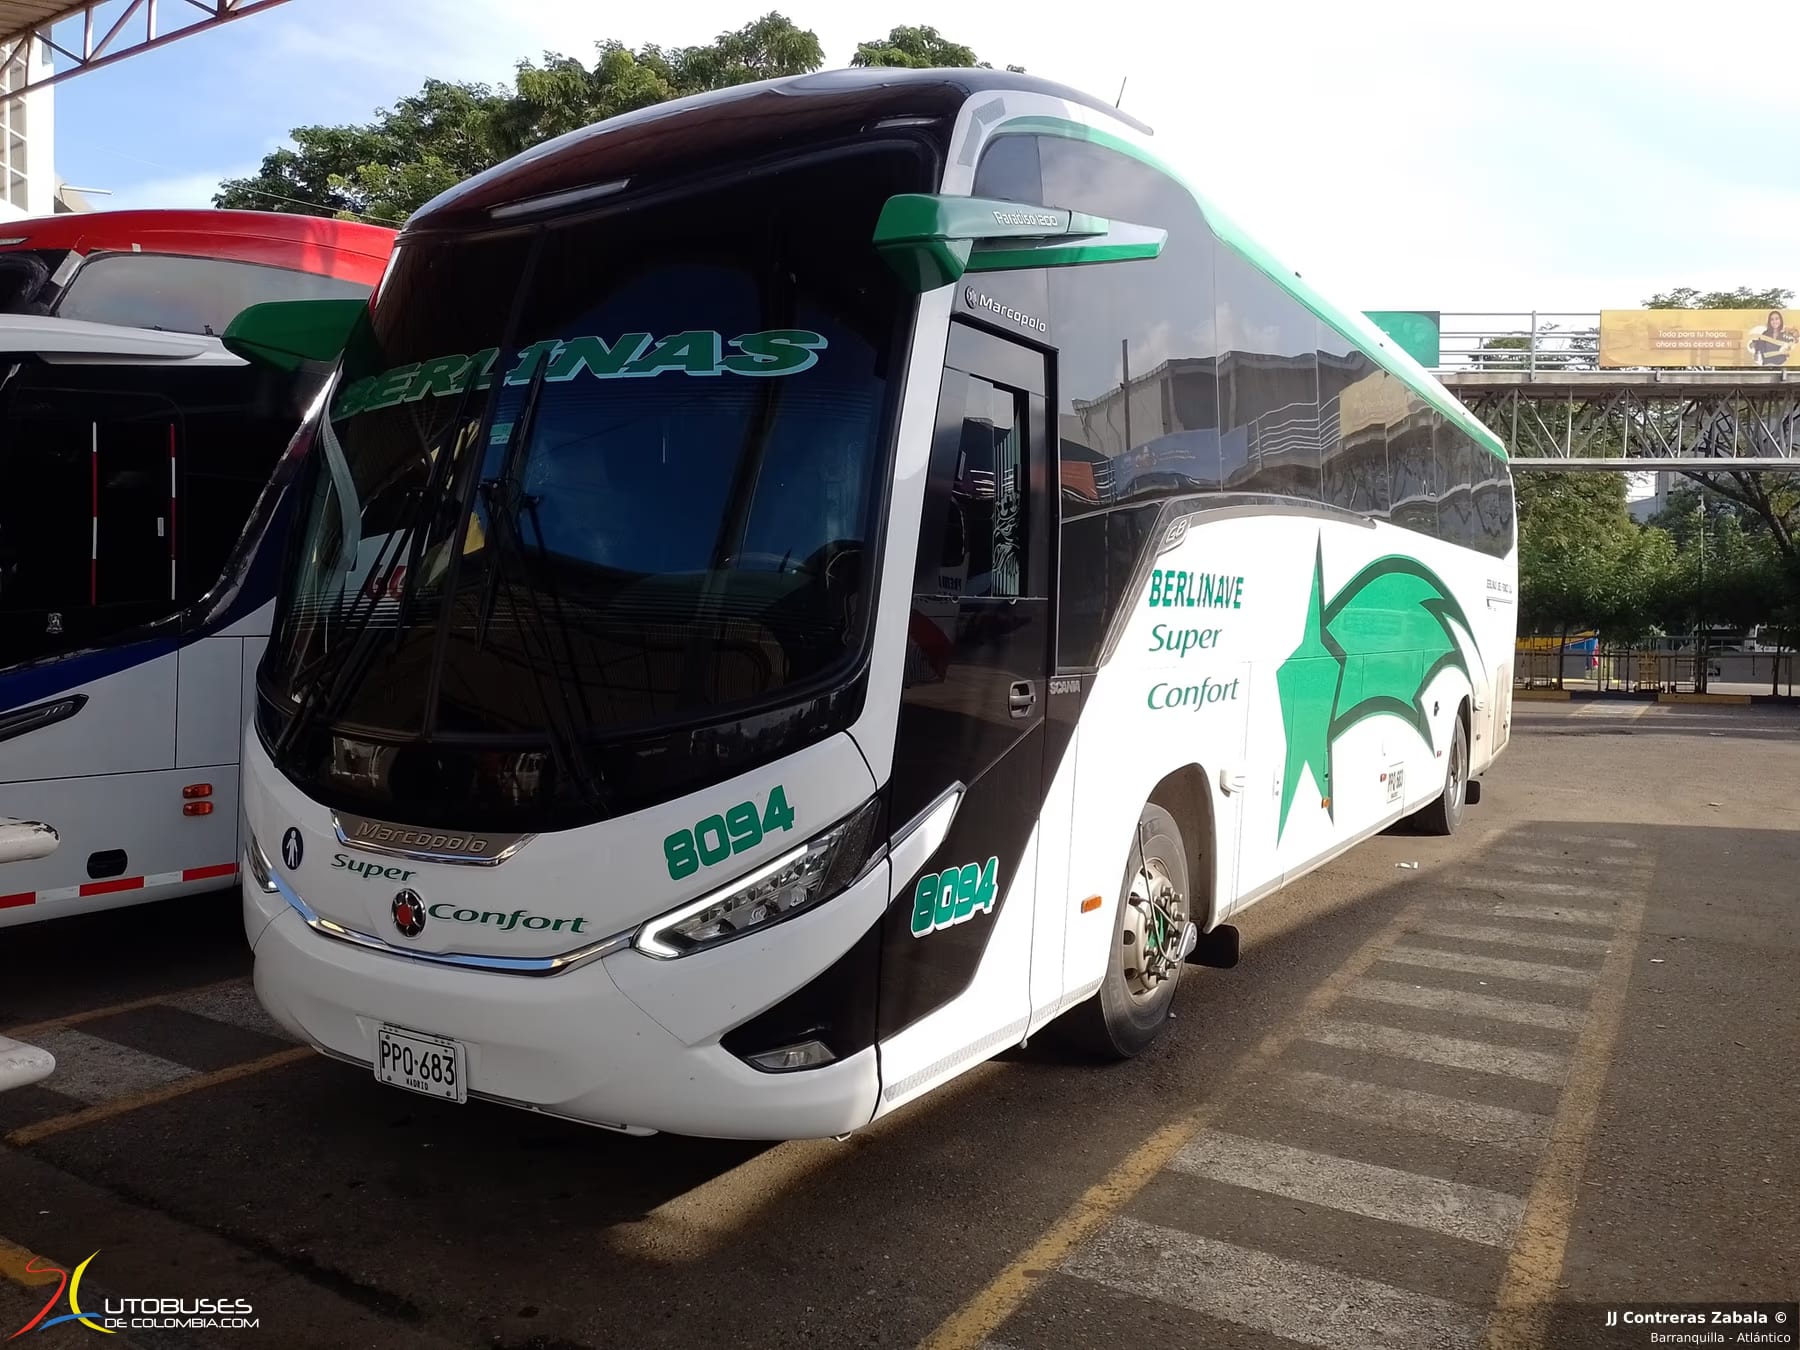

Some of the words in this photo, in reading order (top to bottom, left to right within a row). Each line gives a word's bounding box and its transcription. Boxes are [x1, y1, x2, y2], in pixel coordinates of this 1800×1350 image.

[993, 209, 1036, 225] Paradiso
[978, 293, 1047, 333] Marcopolo
[332, 329, 829, 421] BERLINAS
[1149, 569, 1244, 609] BERLINAVE
[1149, 624, 1222, 657] Super
[1050, 680, 1080, 695] SCANIA
[1148, 677, 1239, 712] Confort
[354, 821, 489, 853] Marcopolo
[664, 785, 795, 881] 8094
[331, 853, 417, 881] Super
[910, 856, 999, 938] 8094
[428, 903, 589, 934] Confort
